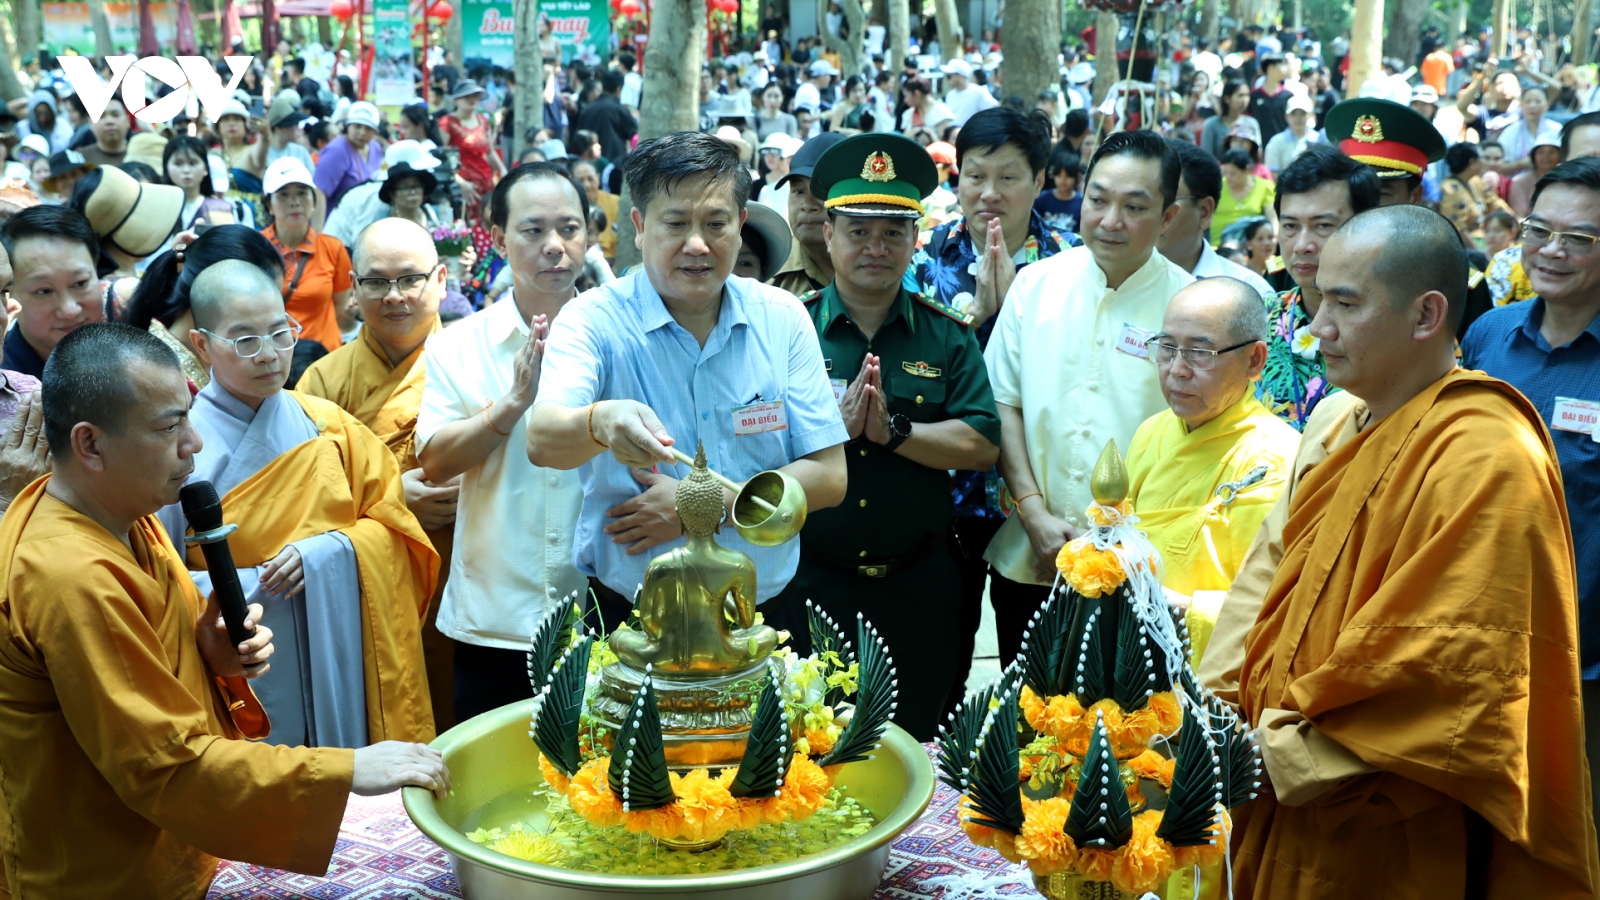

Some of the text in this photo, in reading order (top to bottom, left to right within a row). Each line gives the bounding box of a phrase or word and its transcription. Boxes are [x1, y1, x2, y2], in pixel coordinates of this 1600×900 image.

[741, 412, 777, 427] ĐẠI BIỂU
[1562, 411, 1576, 422] ĐẠI
